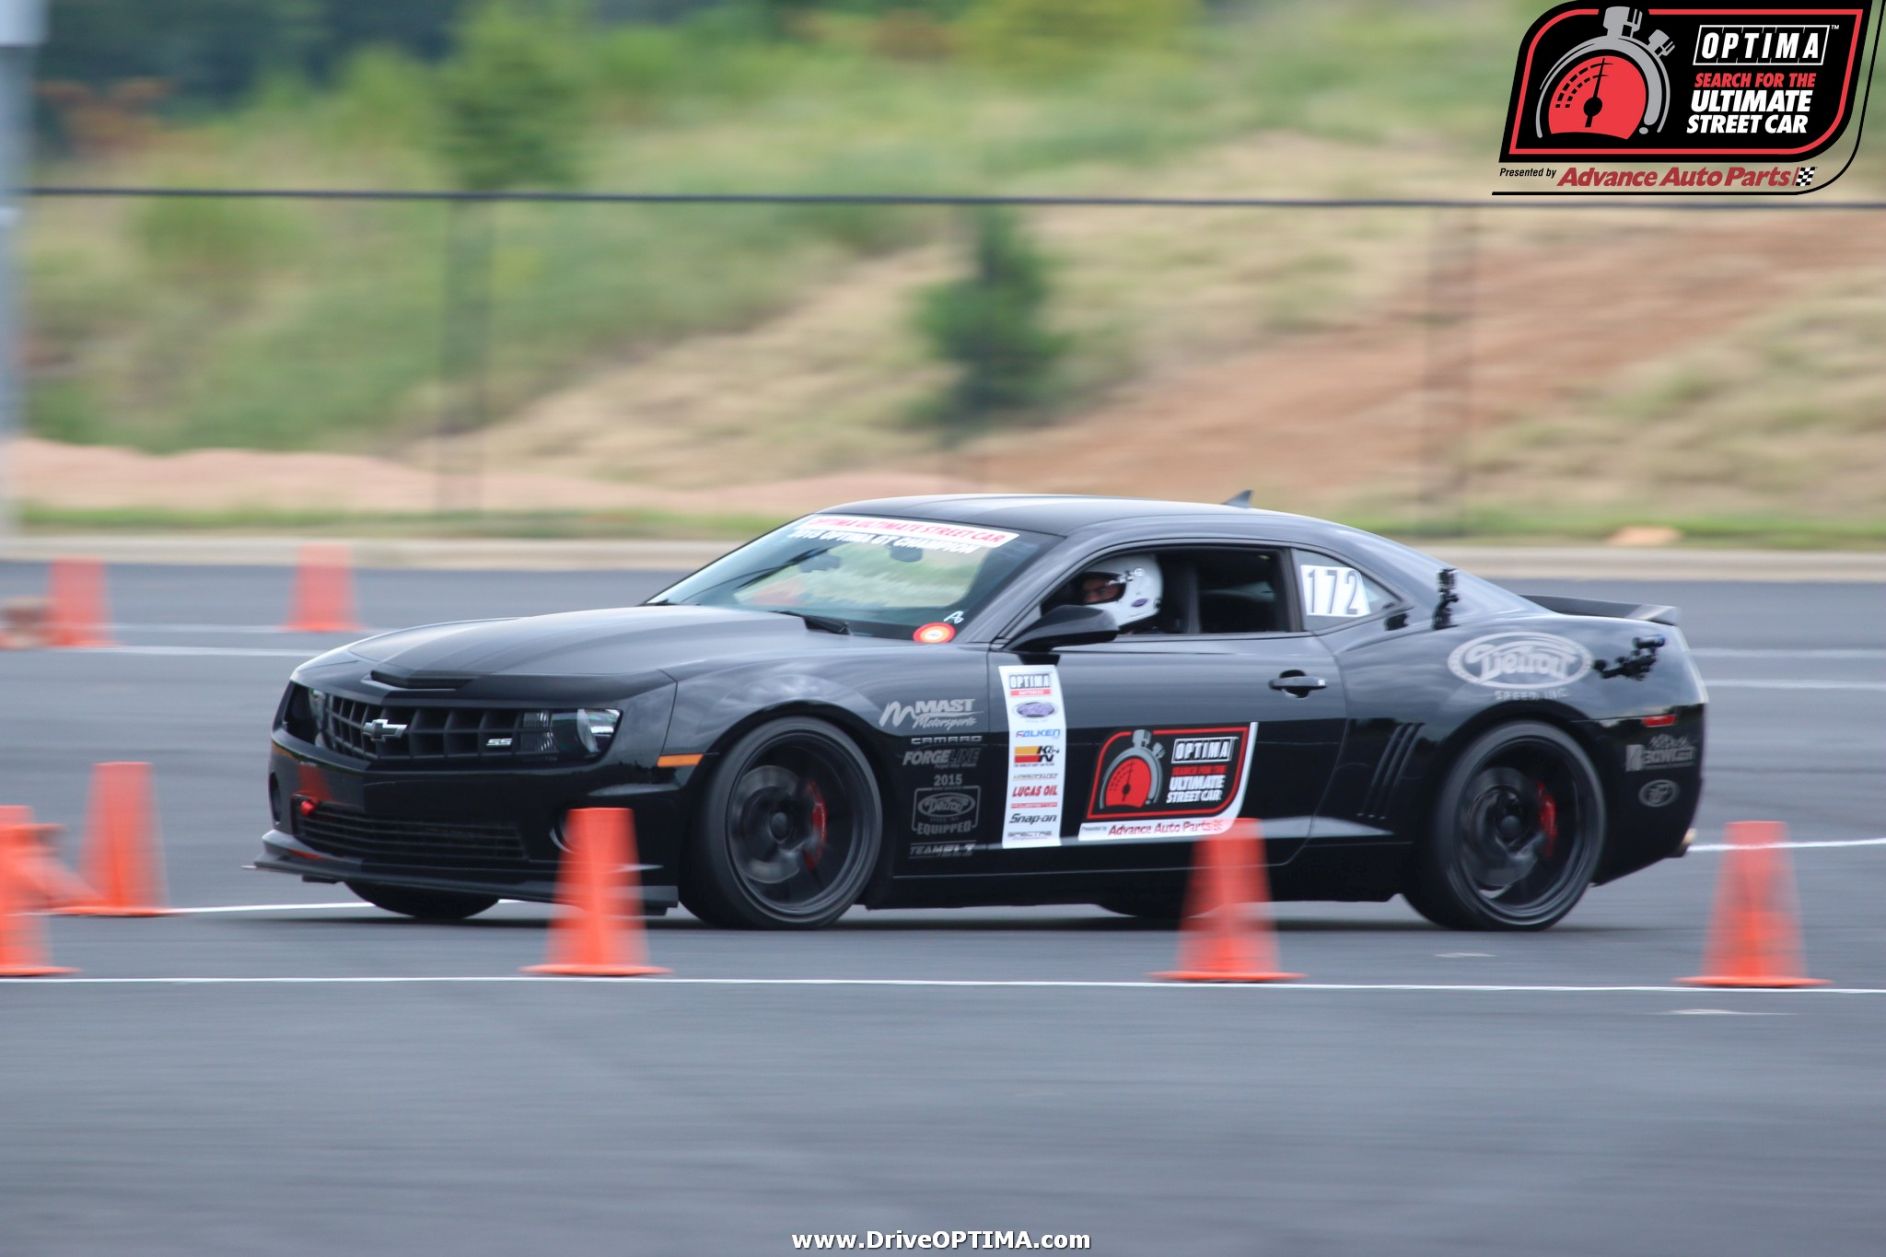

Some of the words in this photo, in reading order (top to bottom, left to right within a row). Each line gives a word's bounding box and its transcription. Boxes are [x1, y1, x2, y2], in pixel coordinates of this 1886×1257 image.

[922, 525, 971, 538] STREET
[971, 530, 1008, 543] CAR
[1307, 569, 1359, 615] 172
[1464, 640, 1578, 683] Detroit
[1010, 674, 1050, 689] OPTIMA
[915, 698, 977, 714] MAST
[912, 716, 978, 732] Motorsports
[911, 735, 983, 745] CAMARO
[1015, 728, 1061, 738] FALKEN
[1174, 741, 1231, 760] OPTIMA
[933, 774, 963, 787] 2015
[1169, 775, 1227, 791] ULTIMATE
[1012, 785, 1042, 797] LUCAS
[1043, 784, 1058, 796] OIL
[1166, 790, 1201, 804] STREET
[1201, 789, 1223, 802] CAR
[1008, 813, 1058, 825] Snap-on
[917, 820, 972, 836] EQUIPPED
[1108, 825, 1152, 836] Advance
[1154, 822, 1181, 834] Auto
[1182, 821, 1214, 833] Parts
